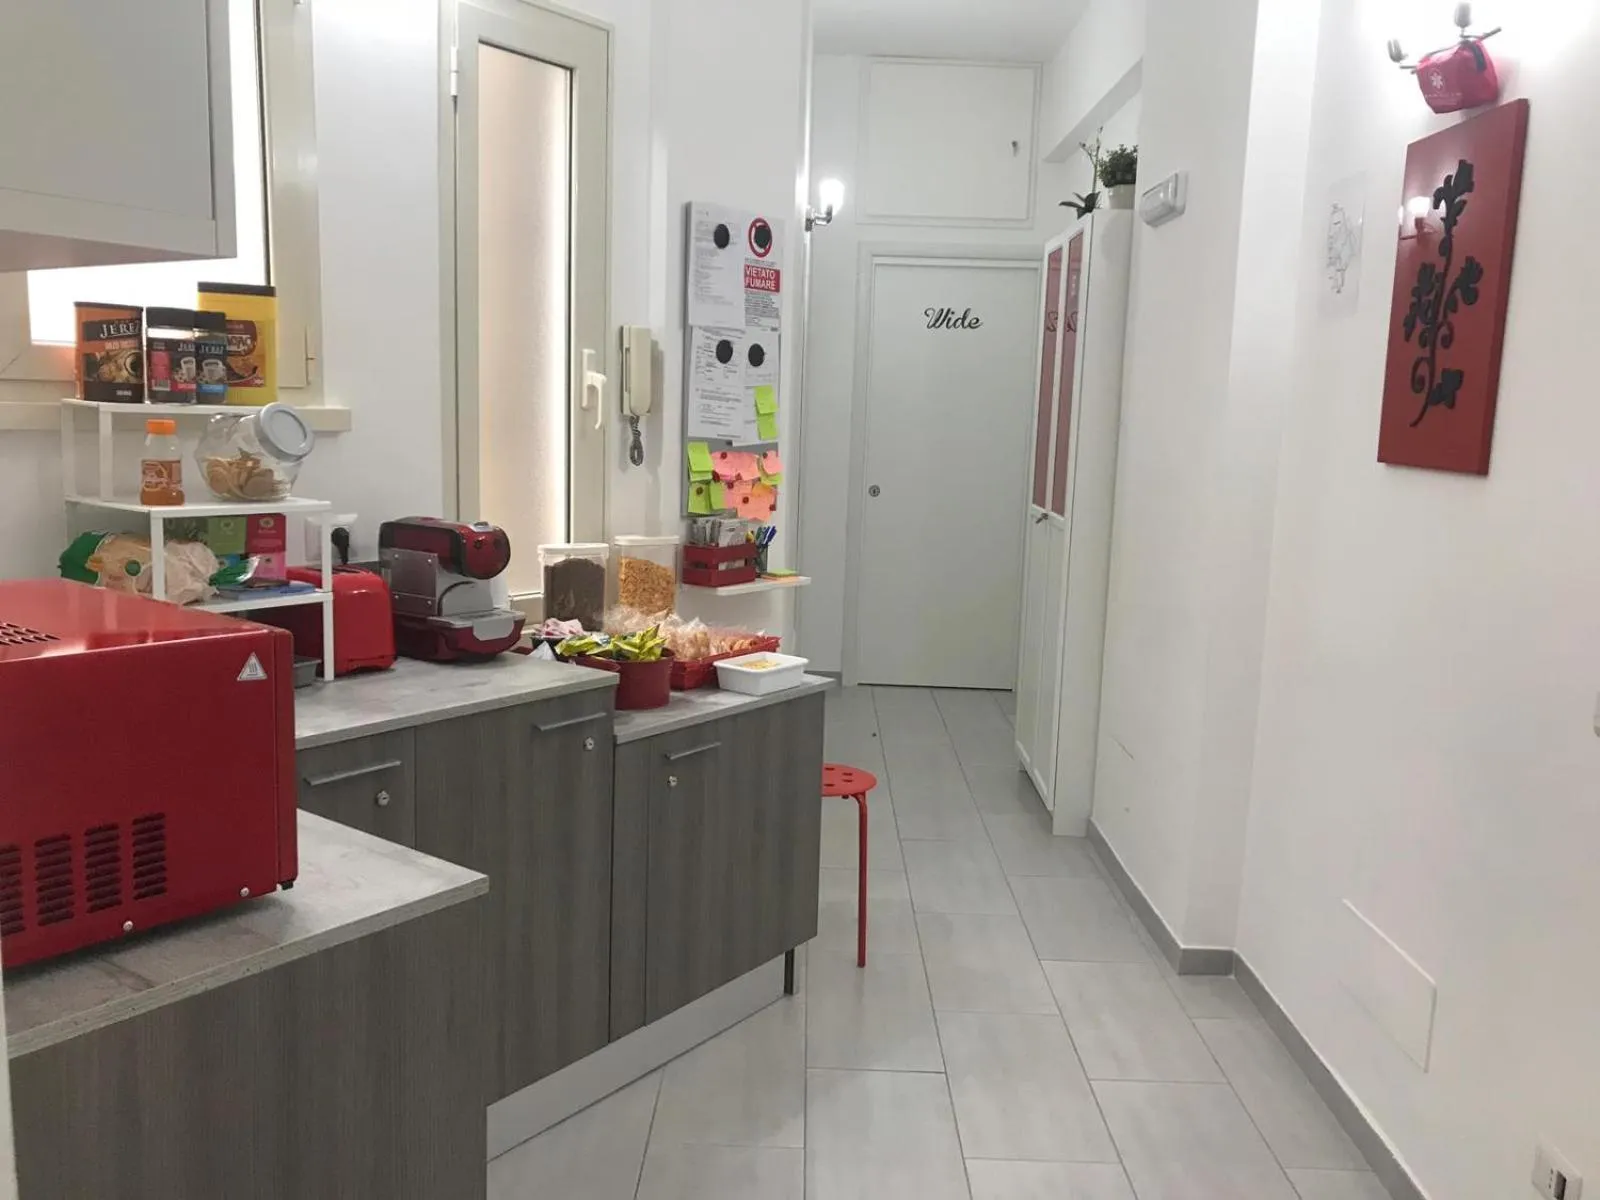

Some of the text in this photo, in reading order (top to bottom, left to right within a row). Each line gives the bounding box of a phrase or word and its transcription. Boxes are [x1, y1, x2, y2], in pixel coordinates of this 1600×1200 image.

[745, 266, 776, 280] VIETATO
[745, 279, 776, 291] FUMARE
[924, 307, 984, 330] Wide
